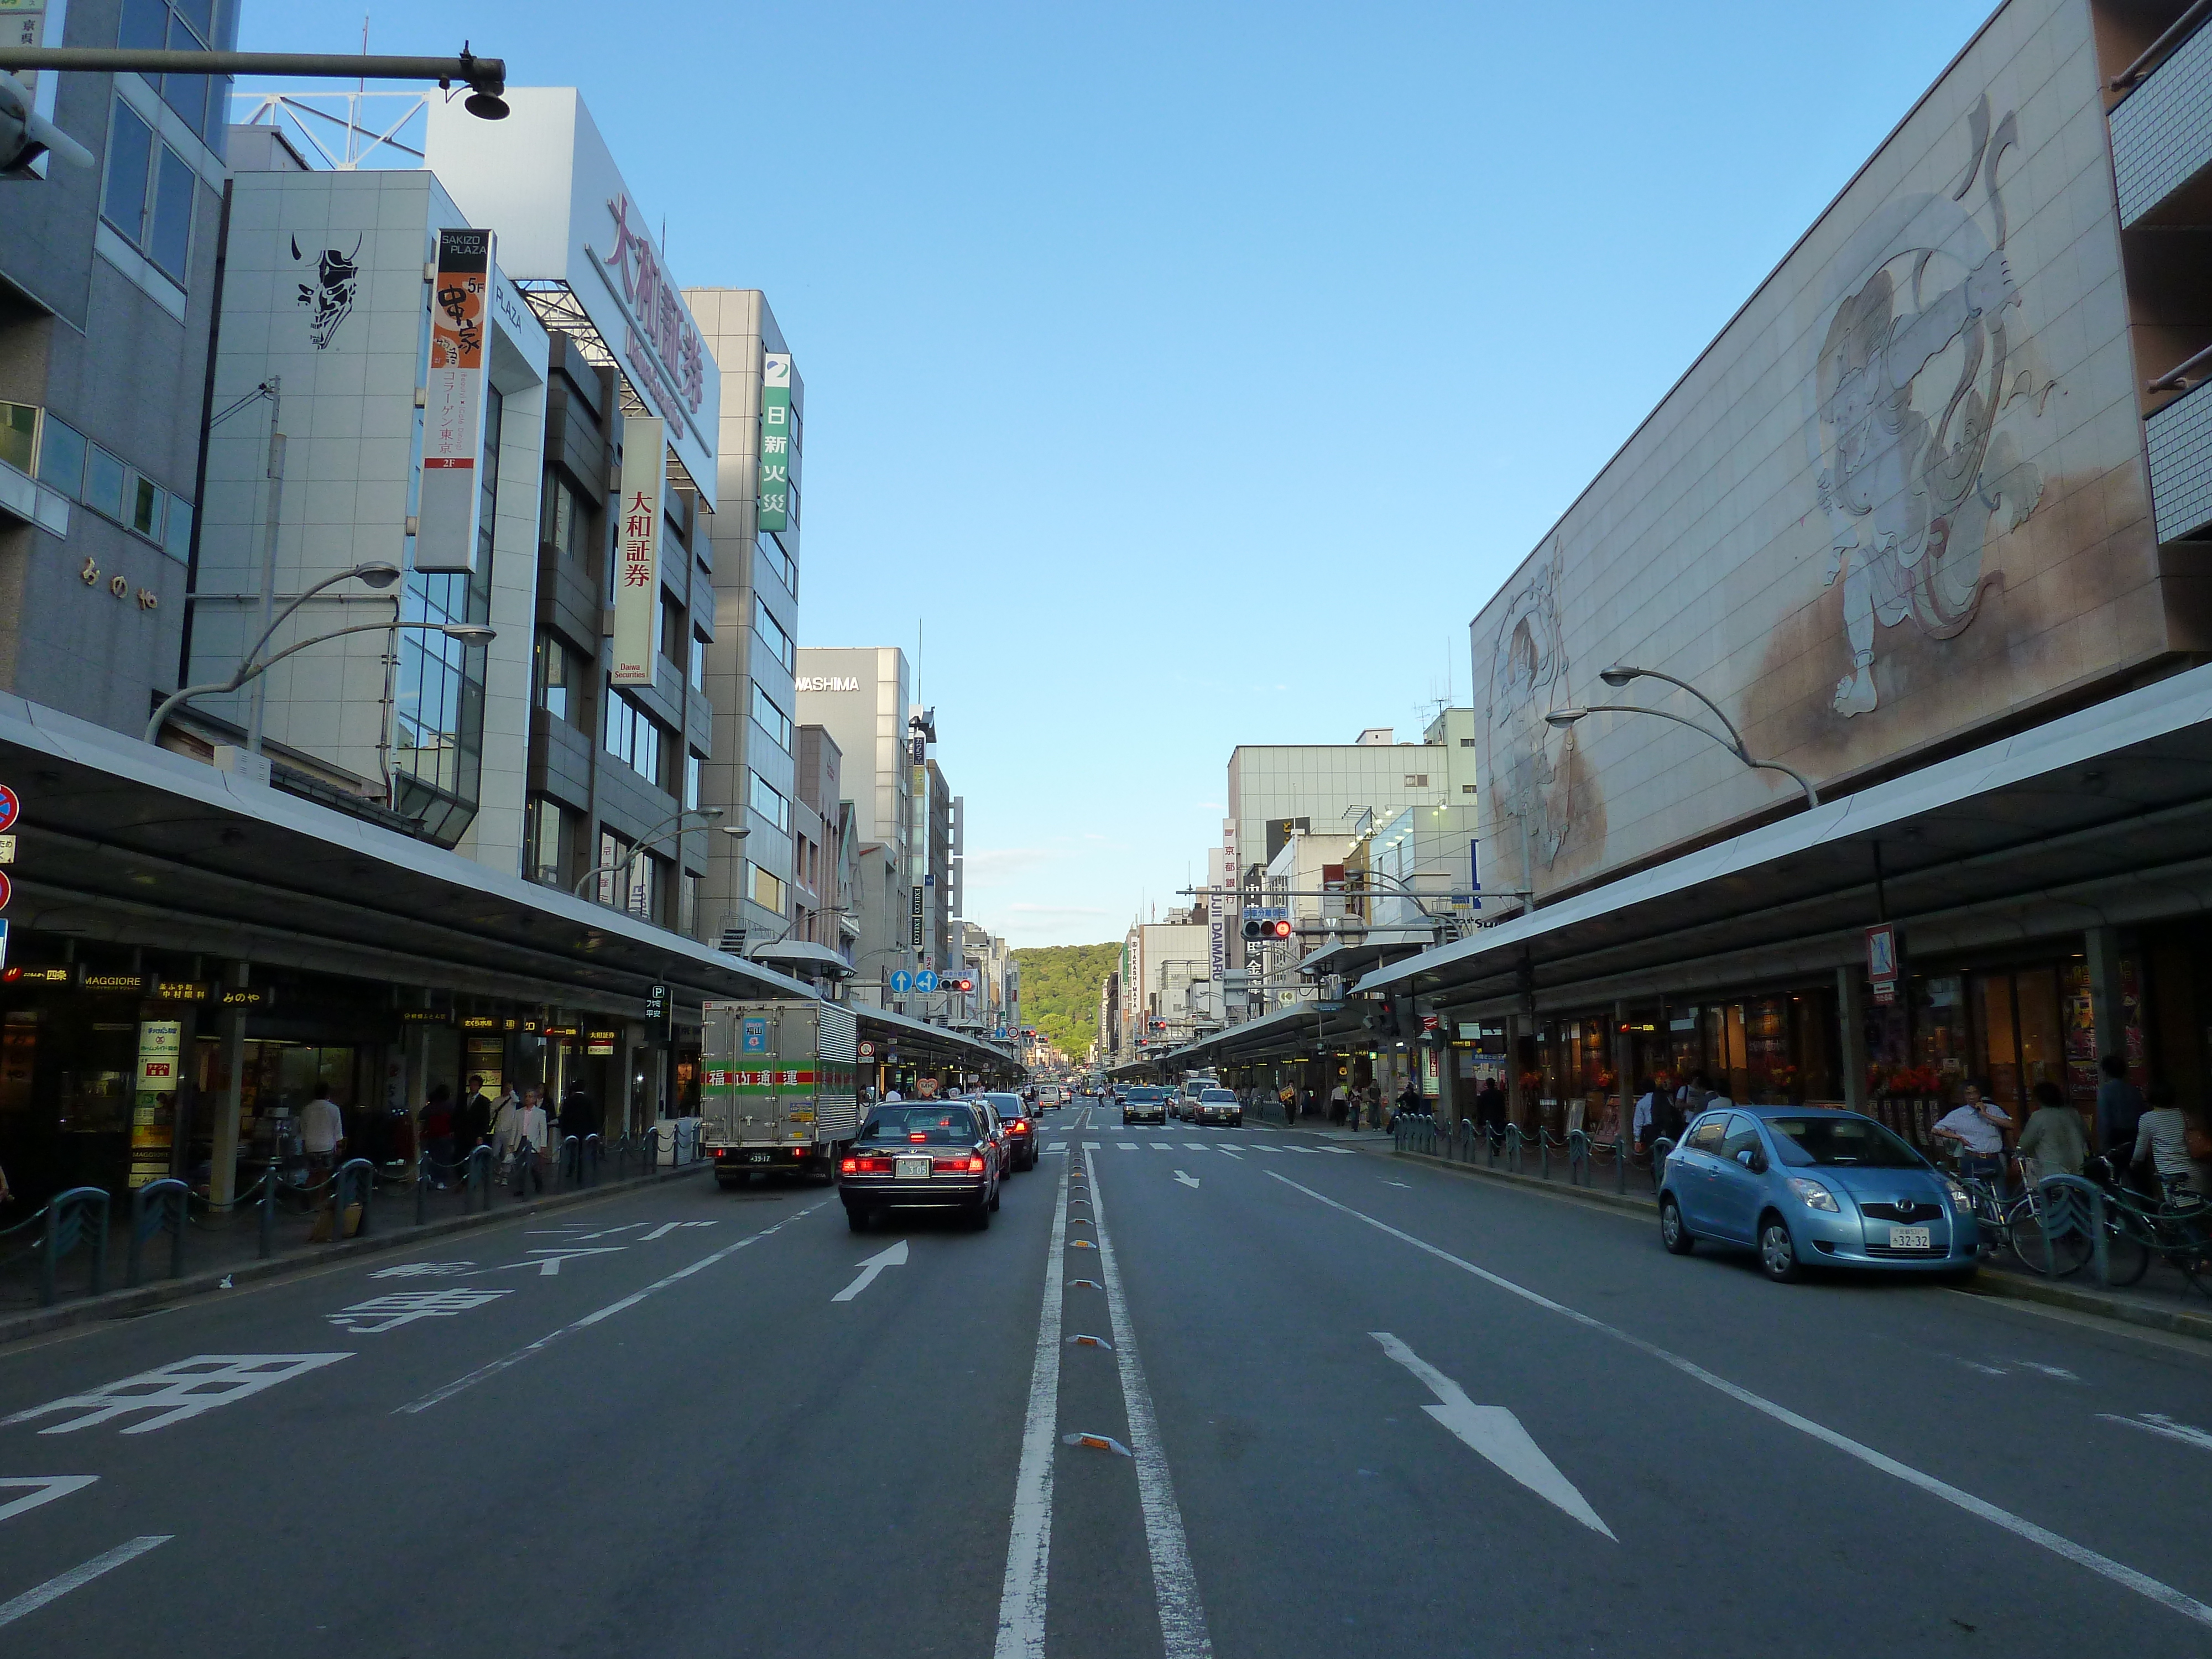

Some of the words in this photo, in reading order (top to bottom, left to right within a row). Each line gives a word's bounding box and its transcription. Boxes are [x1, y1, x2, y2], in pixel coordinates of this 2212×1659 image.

[442, 235, 481, 245] SAKIZO
[450, 245, 487, 255] PLAZA
[468, 278, 484, 293] 5F
[604, 192, 703, 414] 大和証券
[496, 284, 522, 335] PLAZA
[439, 371, 455, 455] コラーゲン東京
[442, 458, 456, 467] 2F
[762, 405, 786, 514] 日新火災
[624, 491, 653, 587] 大和証券
[620, 663, 640, 671] Daiwa
[614, 670, 645, 679] Securities
[1224, 846, 1236, 904] 京都銀行
[1211, 885, 1222, 917] FUJII
[1243, 908, 1287, 917] 歩車分離信号
[1212, 922, 1223, 982] DAIMARU
[46, 969, 67, 981] 四条
[85, 977, 142, 985] MAGGIORE
[222, 992, 261, 1003] みのや
[645, 1010, 661, 1018] 平安
[746, 1027, 763, 1035] 福山
[709, 1069, 799, 1087] 福山通運
[1898, 1235, 1928, 1247] 32-32
